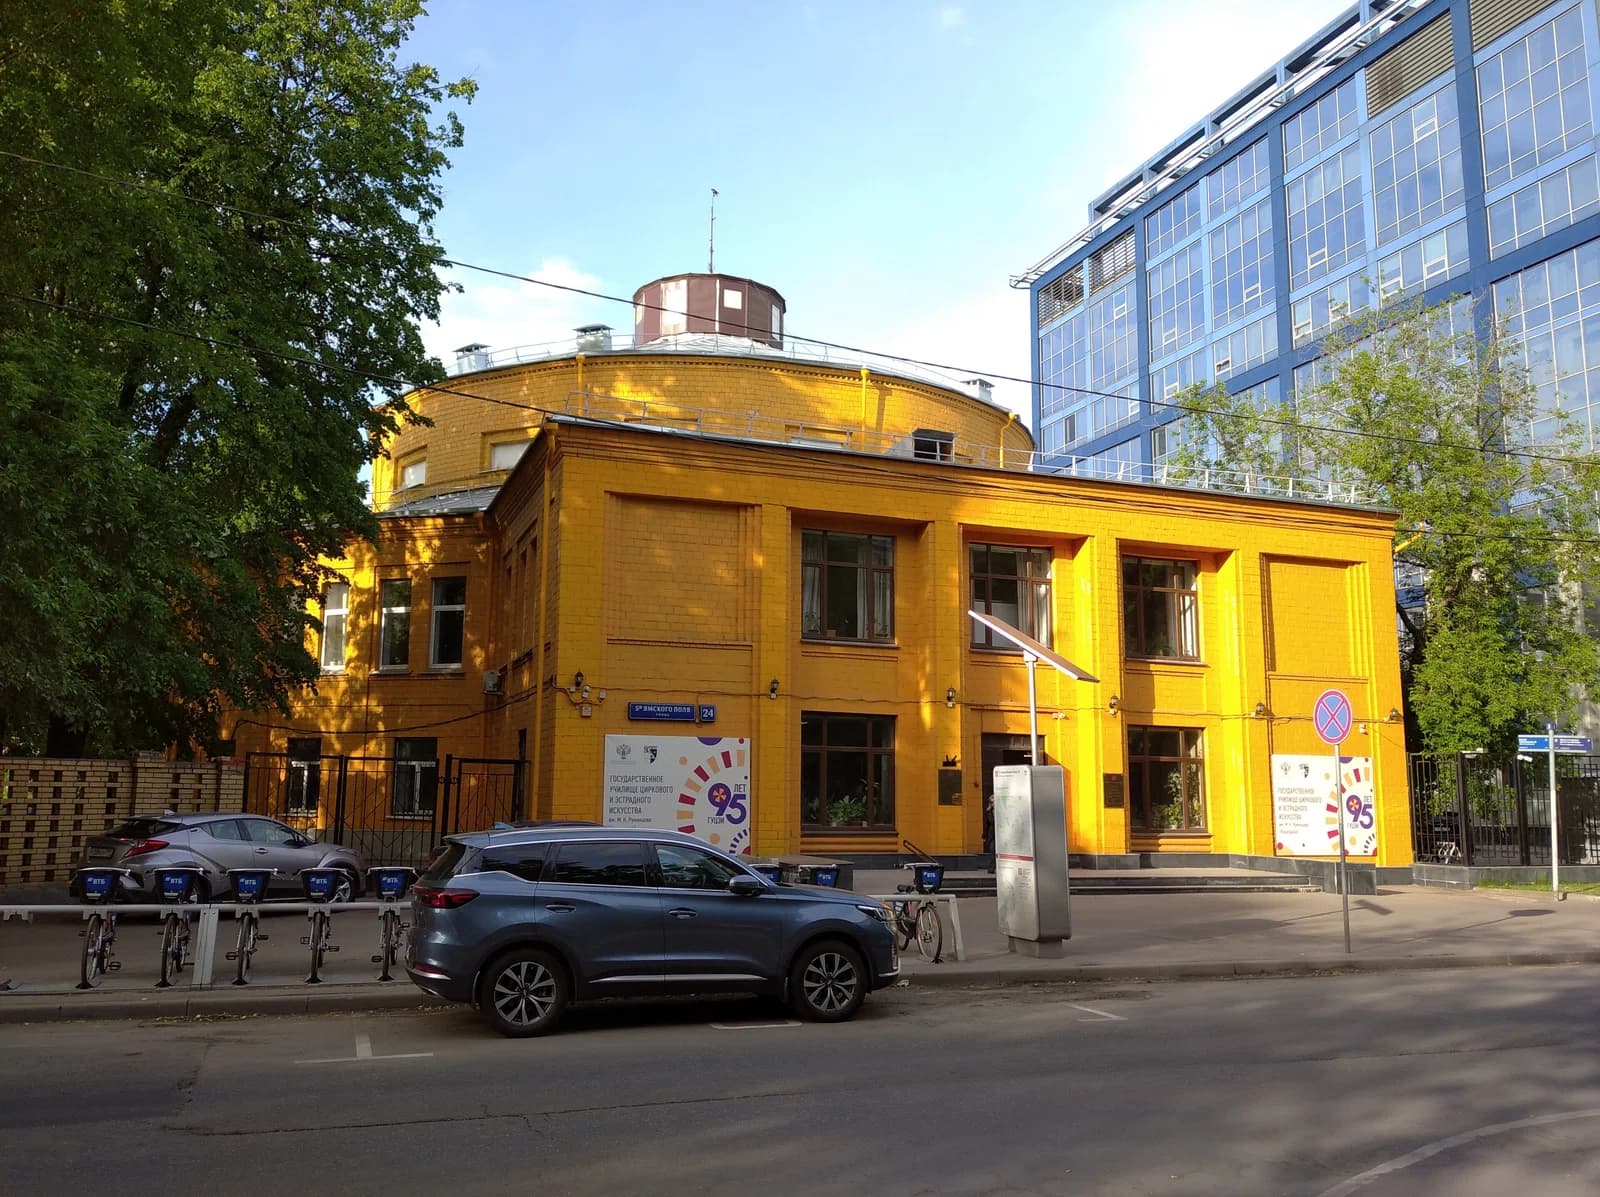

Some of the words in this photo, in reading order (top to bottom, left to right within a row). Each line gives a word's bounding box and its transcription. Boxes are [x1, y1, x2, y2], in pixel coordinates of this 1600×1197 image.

[643, 705, 673, 713] ЯМСКОГО
[702, 708, 714, 718] 24
[609, 775, 664, 783] ГОСУДАРСТВЕННОЕ
[609, 785, 638, 793] УЧИЛИЩЕ
[639, 785, 674, 793] ЦИРКОВОГО
[609, 796, 614, 804] И
[615, 796, 652, 804] ЭСТРАДНОГО
[708, 783, 746, 824] 95
[733, 784, 746, 792] ЛЕТ
[609, 806, 642, 814] ИСКУССТВА
[1346, 795, 1373, 829] 95
